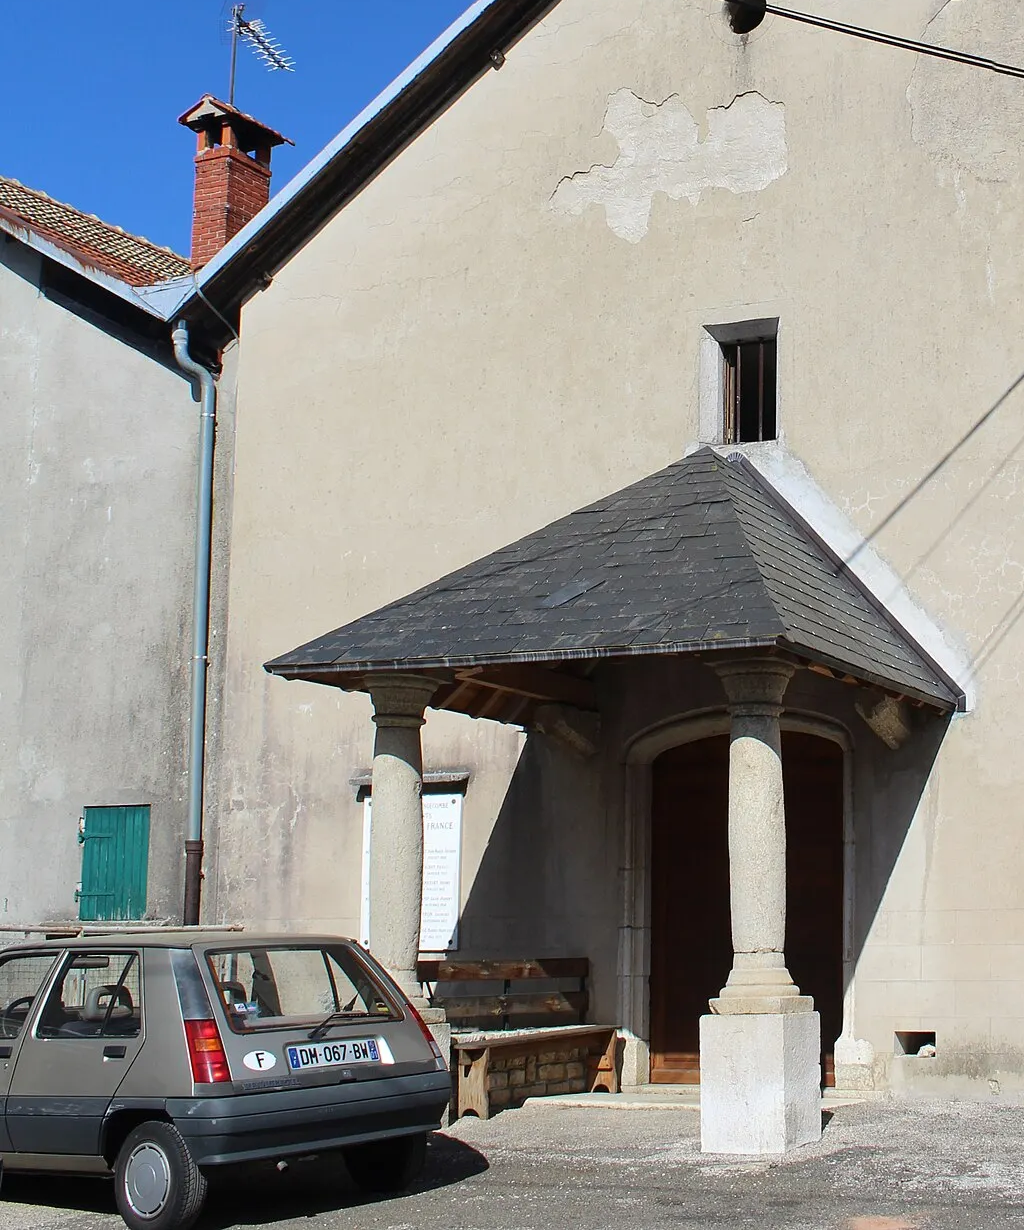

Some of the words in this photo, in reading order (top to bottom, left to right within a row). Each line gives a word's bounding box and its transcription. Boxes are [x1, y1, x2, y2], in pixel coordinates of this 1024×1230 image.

[426, 821, 454, 831] FRANCE
[255, 1052, 265, 1068] F
[299, 1042, 369, 1066] DM-067-BW
